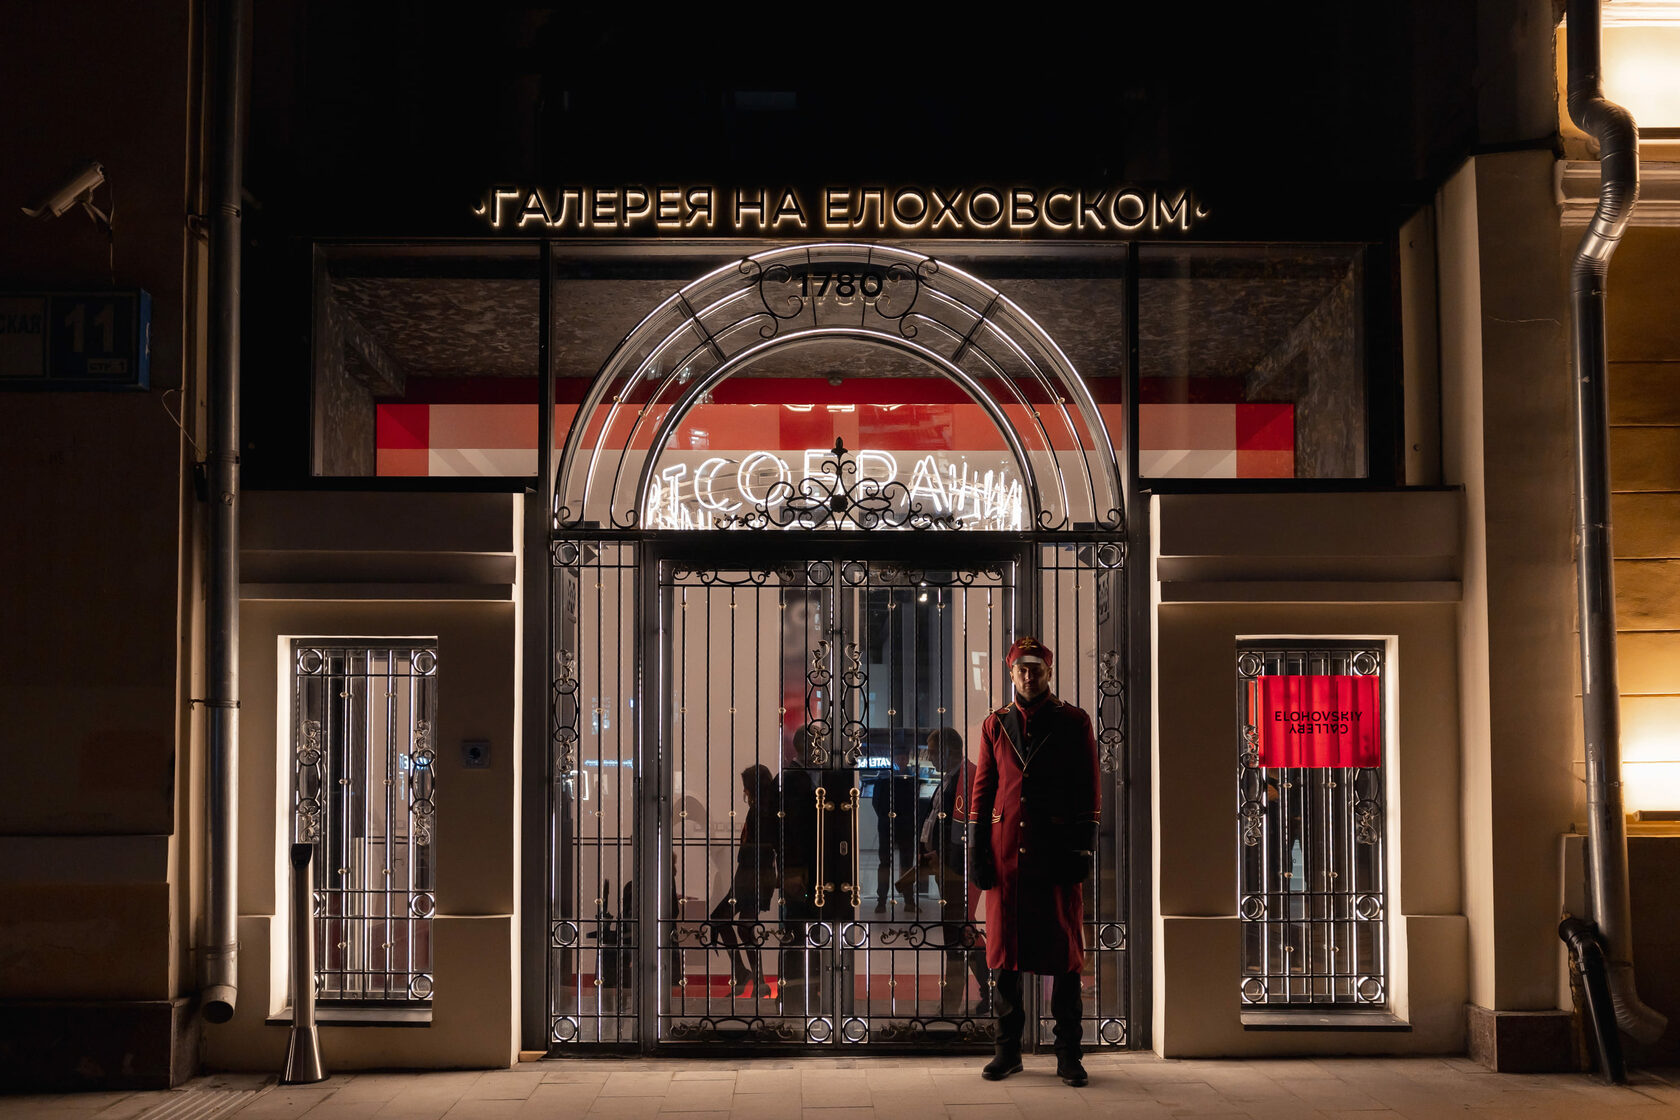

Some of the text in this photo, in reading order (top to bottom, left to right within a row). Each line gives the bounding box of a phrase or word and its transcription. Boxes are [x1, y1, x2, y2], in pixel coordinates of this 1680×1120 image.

[490, 185, 1191, 230] ГАЛЕРЕЯ НА ЕЛОХОВСКОМ
[799, 272, 883, 297] 1780
[64, 303, 115, 352] 11
[1274, 711, 1363, 722] ELOHOVSKIY
[1288, 723, 1349, 734] GALLERY
